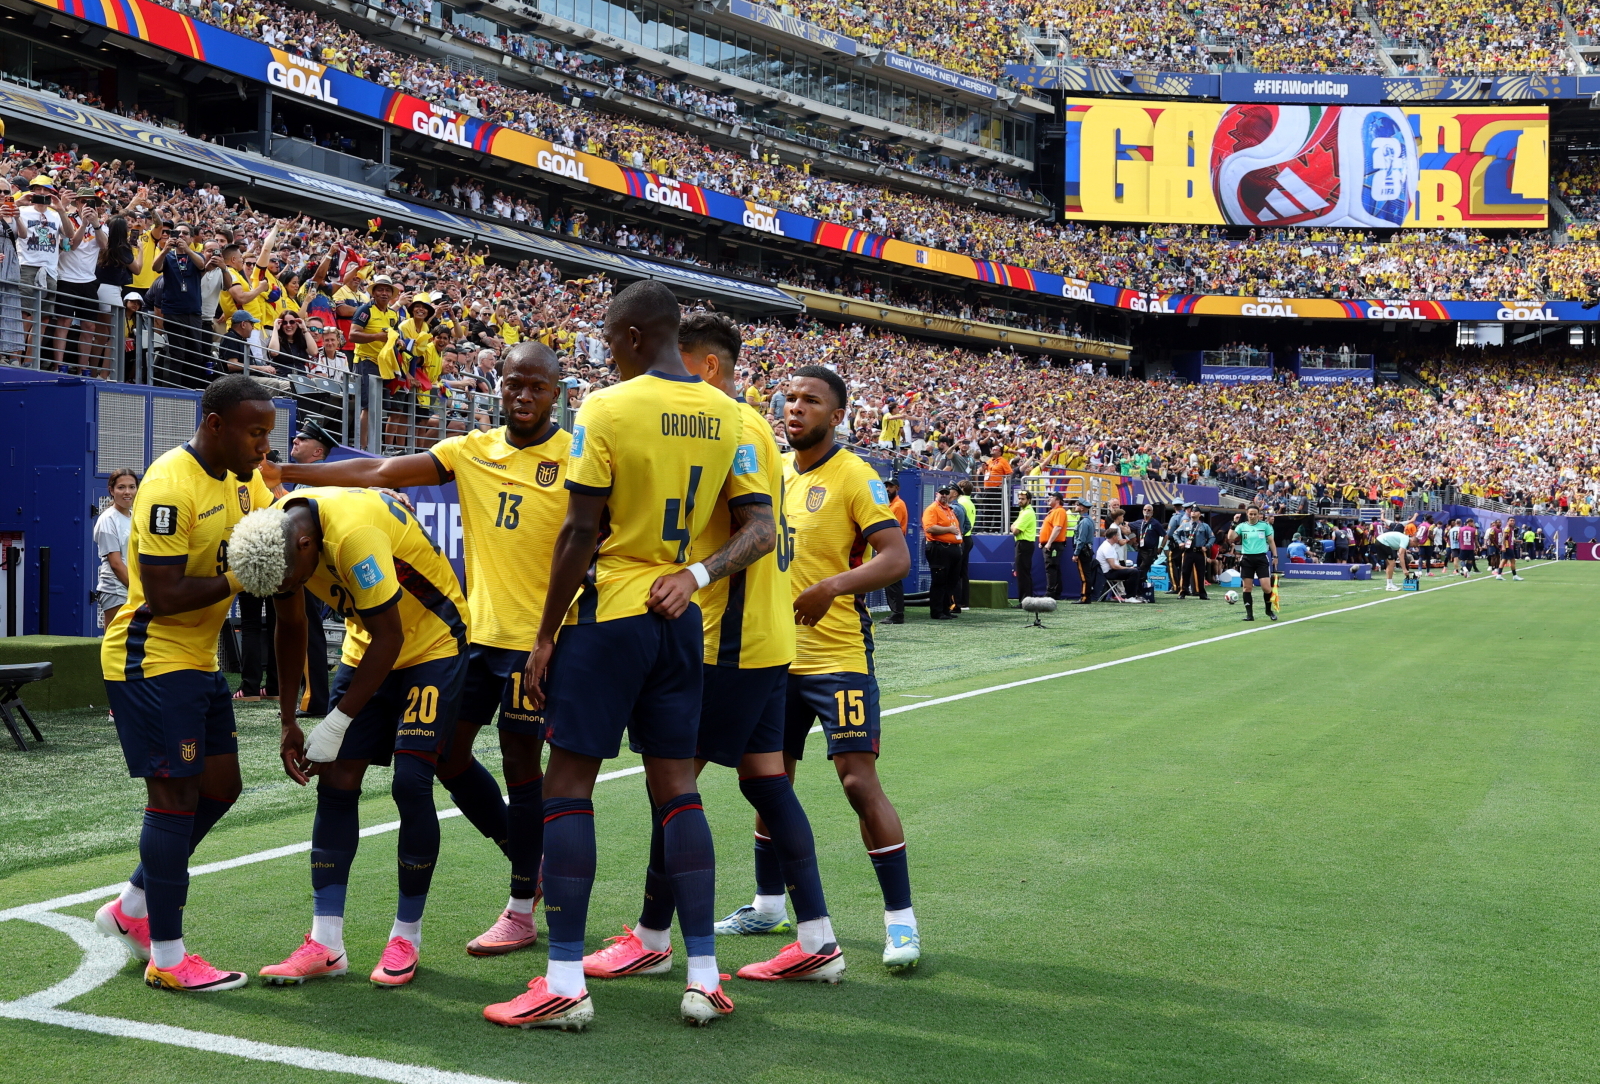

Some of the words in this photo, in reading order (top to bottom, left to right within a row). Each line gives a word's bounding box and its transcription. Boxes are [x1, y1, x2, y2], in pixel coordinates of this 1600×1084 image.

[267, 61, 339, 106] GOAL
[891, 56, 912, 70] NEW
[913, 62, 938, 77] YORK
[939, 72, 959, 85] NEW
[960, 78, 993, 95] JERSEY
[1253, 79, 1349, 98] #FIFAWorldCup
[412, 111, 473, 149] GOAL
[537, 150, 590, 184] GOAL
[645, 182, 693, 212] GOAL
[742, 210, 785, 236] GOAL
[1062, 284, 1096, 303] GOAL
[1130, 297, 1176, 314] GOAL
[1241, 303, 1298, 318] GOAL
[1367, 306, 1427, 320] GOAL
[1497, 308, 1559, 321] GOAL
[661, 411, 721, 441] ORDOÑEZ
[471, 456, 507, 470] marathon
[198, 504, 224, 520] marathon
[495, 491, 523, 530] 13
[661, 465, 703, 563] 4
[416, 502, 466, 559] FIF
[216, 539, 229, 577] 9
[403, 685, 439, 724] 20
[834, 689, 866, 727] 15
[398, 728, 435, 737] marathon
[831, 730, 868, 740] marathon
